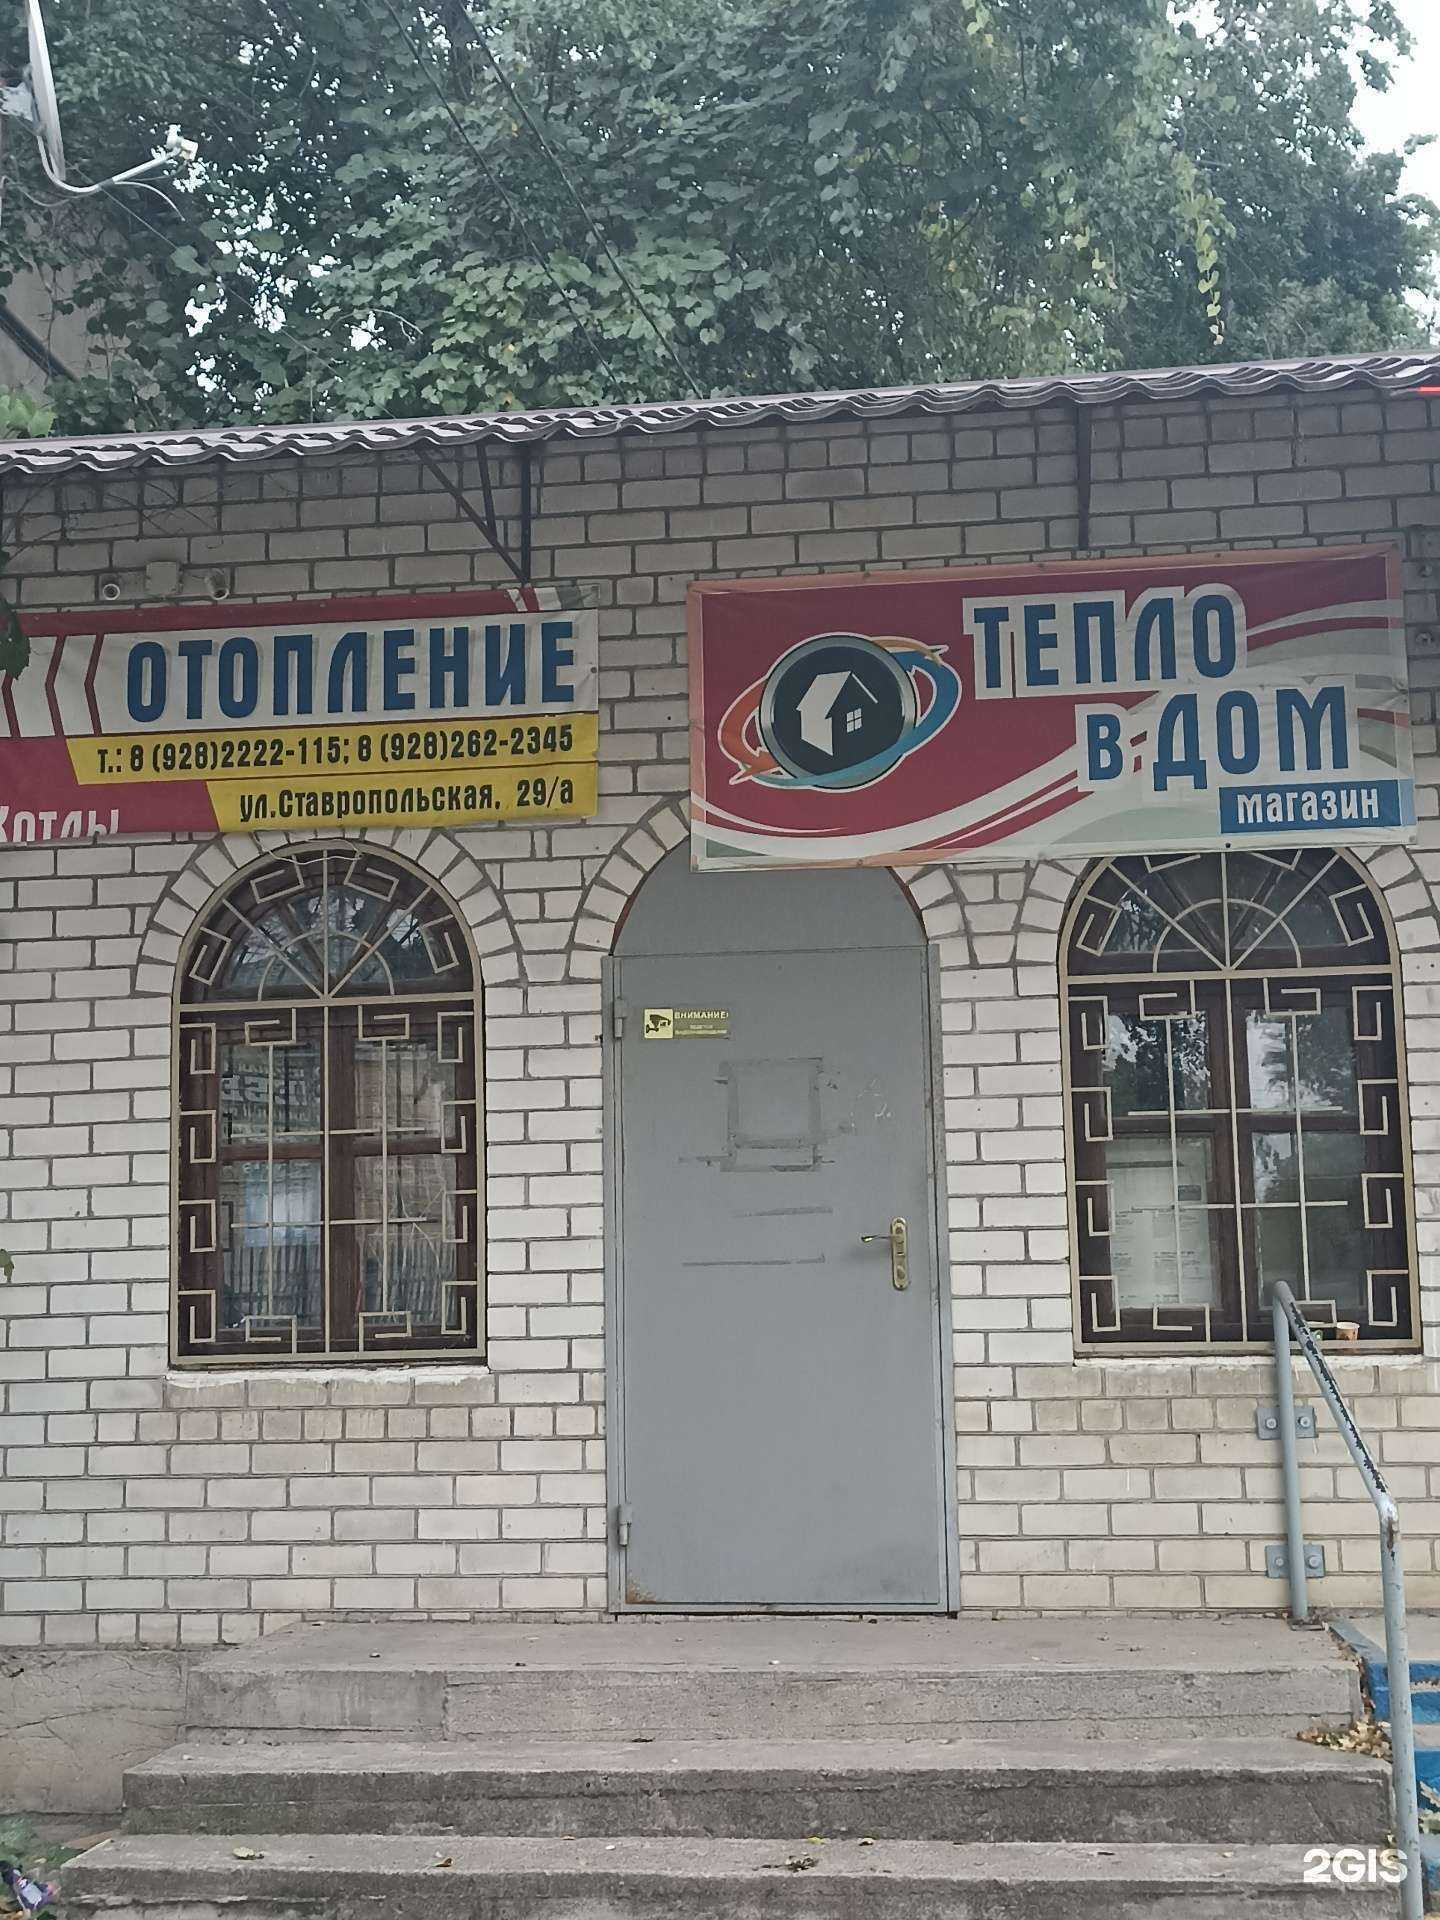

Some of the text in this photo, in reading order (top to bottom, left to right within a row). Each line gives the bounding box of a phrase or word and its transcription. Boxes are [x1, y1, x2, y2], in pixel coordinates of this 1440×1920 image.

[126, 620, 575, 723] ОТОПЛЕНИЕ
[972, 593, 1238, 689] ТЕПЛО
[129, 744, 145, 772] 8
[152, 735, 350, 773] (928)2222-115;
[357, 734, 373, 762] 8
[380, 724, 573, 762] (928)262-2345
[1086, 685, 1349, 792] В ДОМ
[516, 776, 574, 808] 29/а
[1237, 785, 1379, 824] магазин
